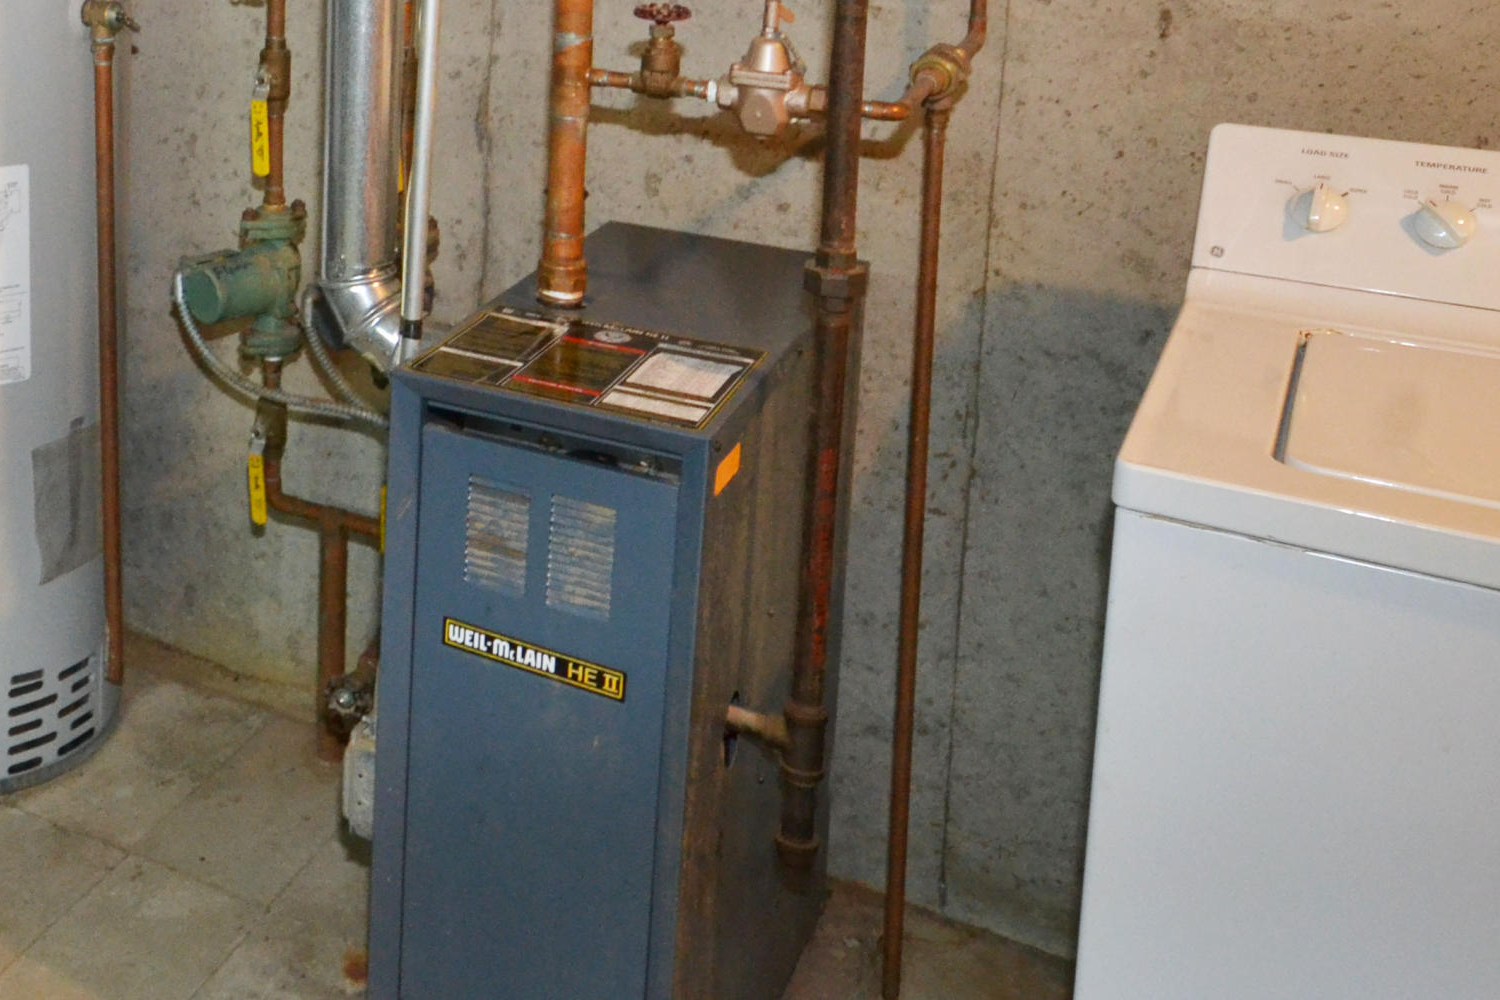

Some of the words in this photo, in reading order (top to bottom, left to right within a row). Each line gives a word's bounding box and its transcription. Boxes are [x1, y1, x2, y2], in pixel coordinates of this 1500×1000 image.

[1415, 160, 1488, 174] TEMPERATURE
[566, 662, 599, 687] HE
[603, 672, 620, 694] II
